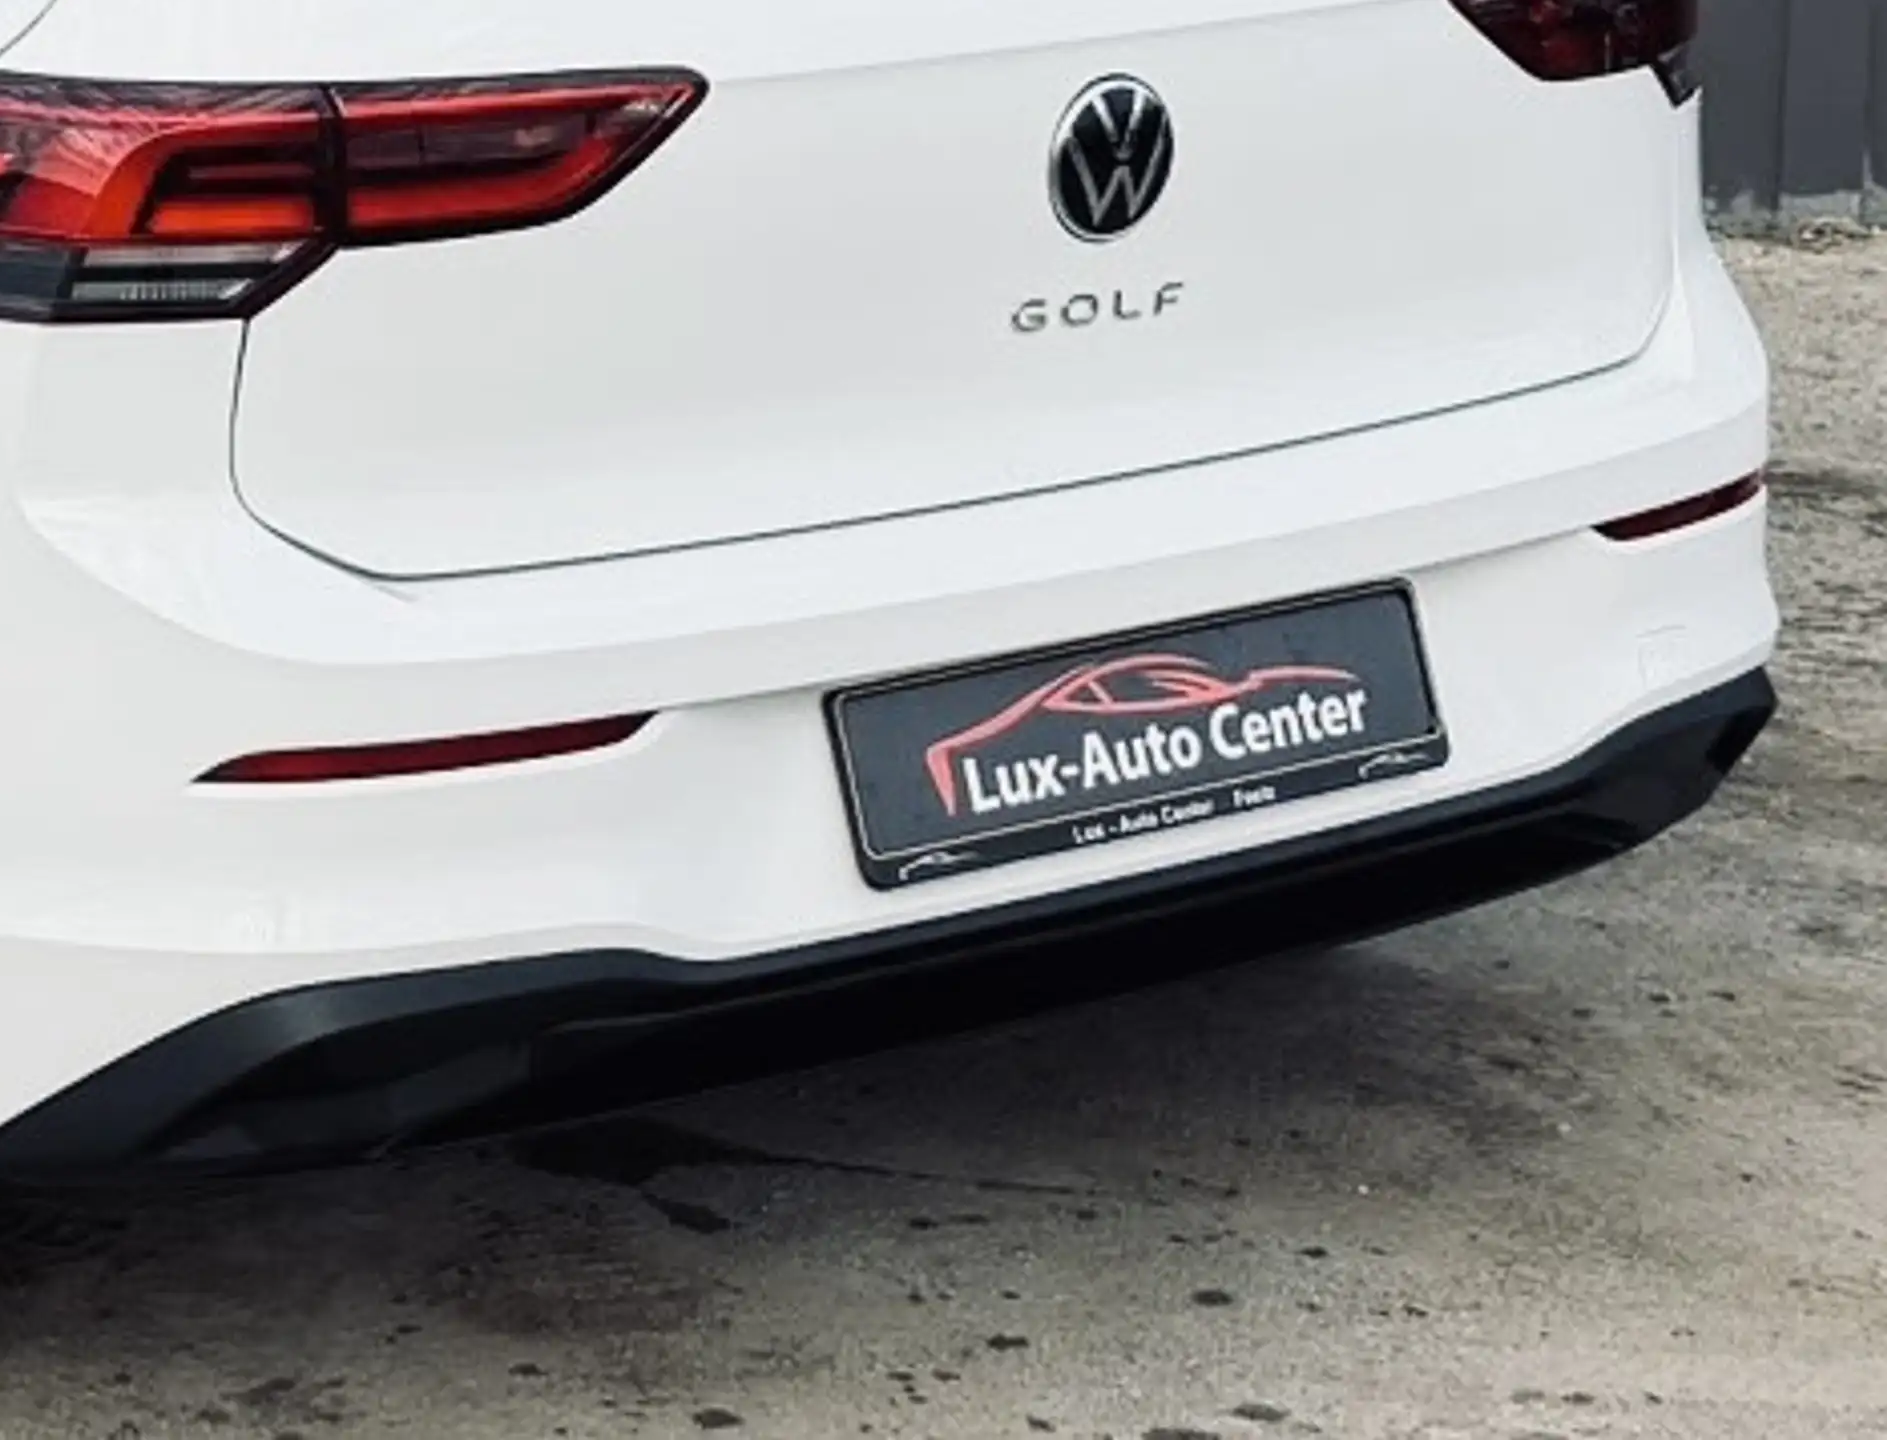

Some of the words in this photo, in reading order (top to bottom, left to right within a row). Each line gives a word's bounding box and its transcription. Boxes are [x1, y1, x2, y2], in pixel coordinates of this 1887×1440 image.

[1011, 281, 1183, 332] GOLF
[961, 723, 1202, 815] Lux-Auto
[1209, 685, 1368, 760] Center
